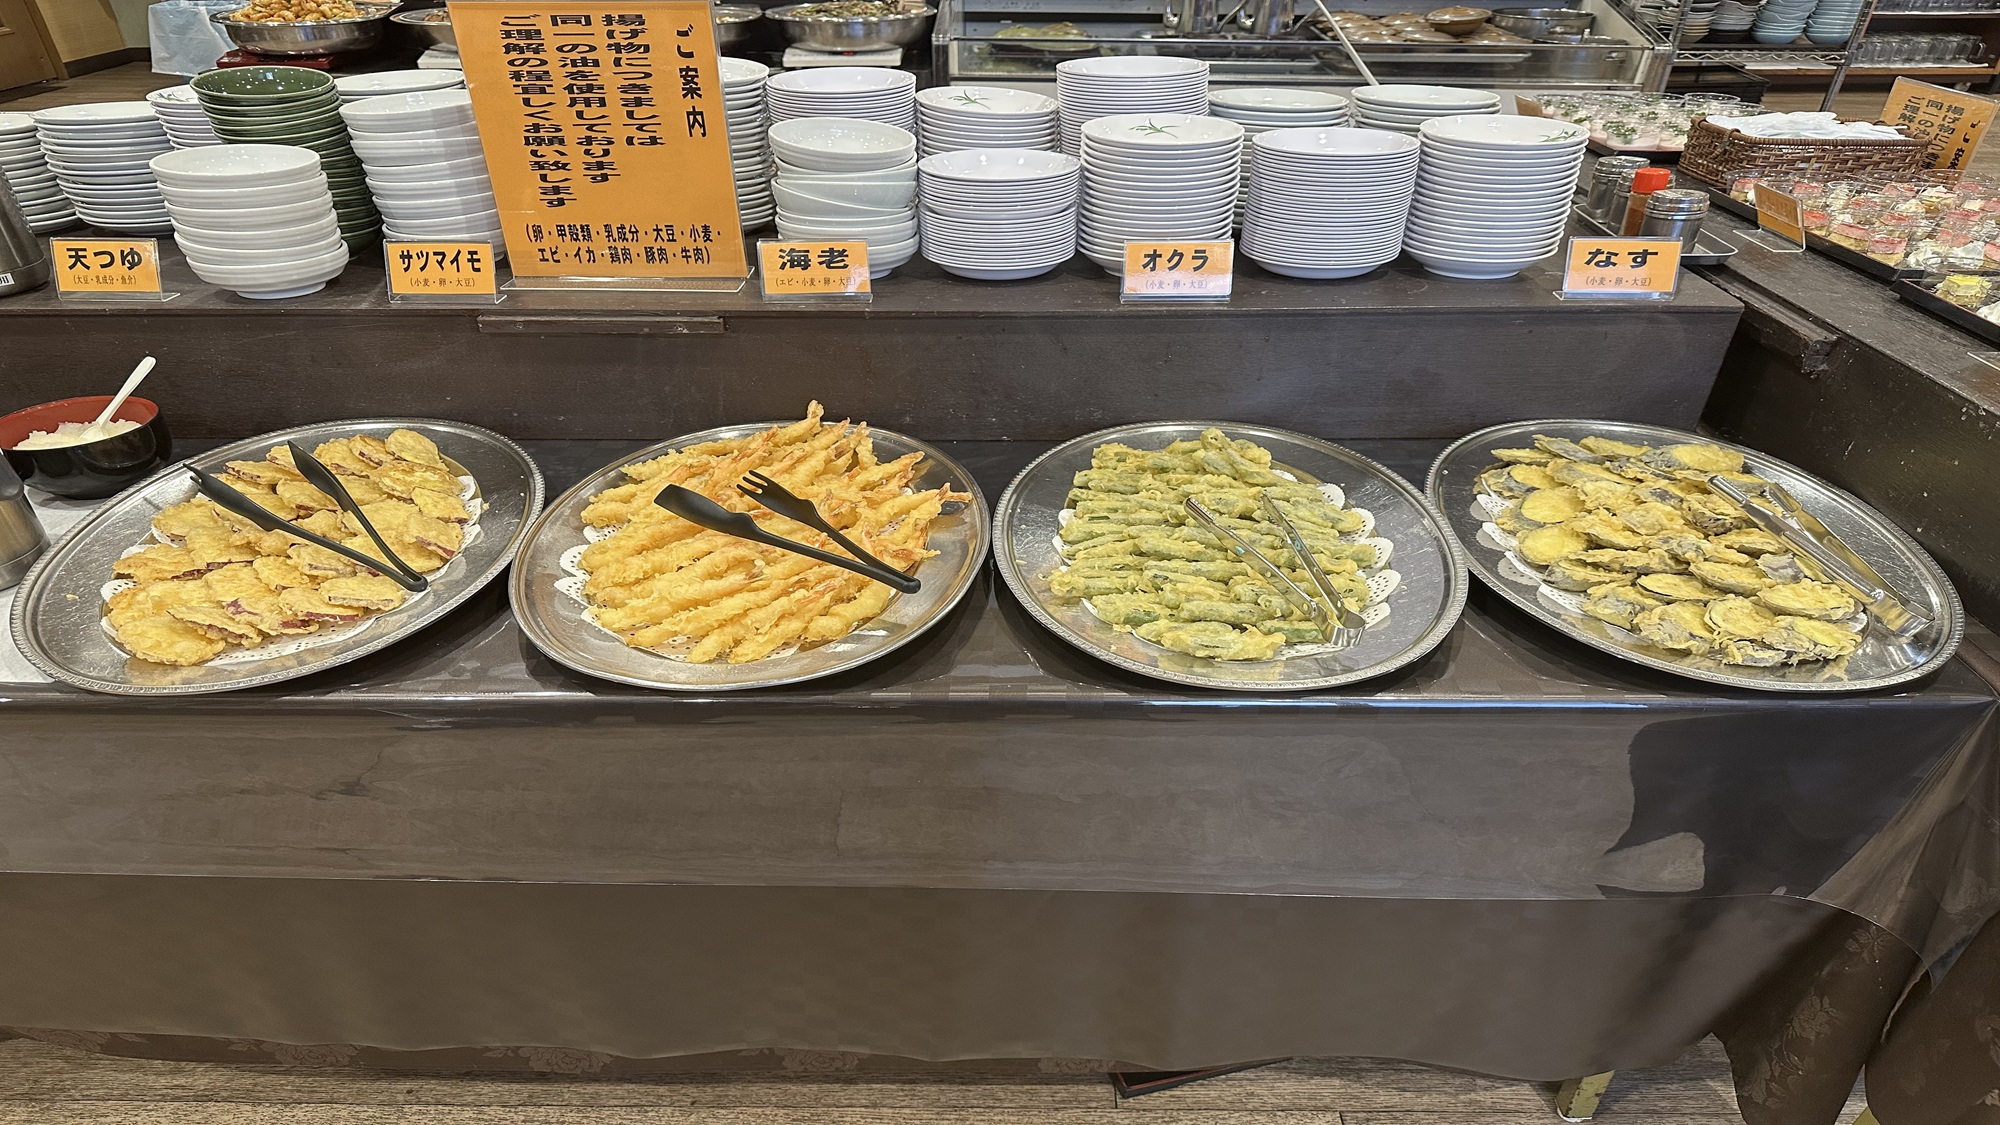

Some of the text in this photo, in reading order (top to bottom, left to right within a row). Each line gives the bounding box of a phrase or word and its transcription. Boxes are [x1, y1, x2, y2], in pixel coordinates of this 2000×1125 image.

[601, 14, 666, 146] 揚げ物につきましては
[675, 24, 707, 137] ご案内
[499, 13, 577, 207] ご理解の程宜しくお願い致します
[550, 14, 621, 183] 同一の油を使用しております
[66, 247, 143, 271] 天つゆ
[399, 249, 482, 273] サツマイモ
[778, 247, 850, 271] 海老
[1141, 249, 1209, 272] オクラ
[1583, 248, 1659, 269] なす
